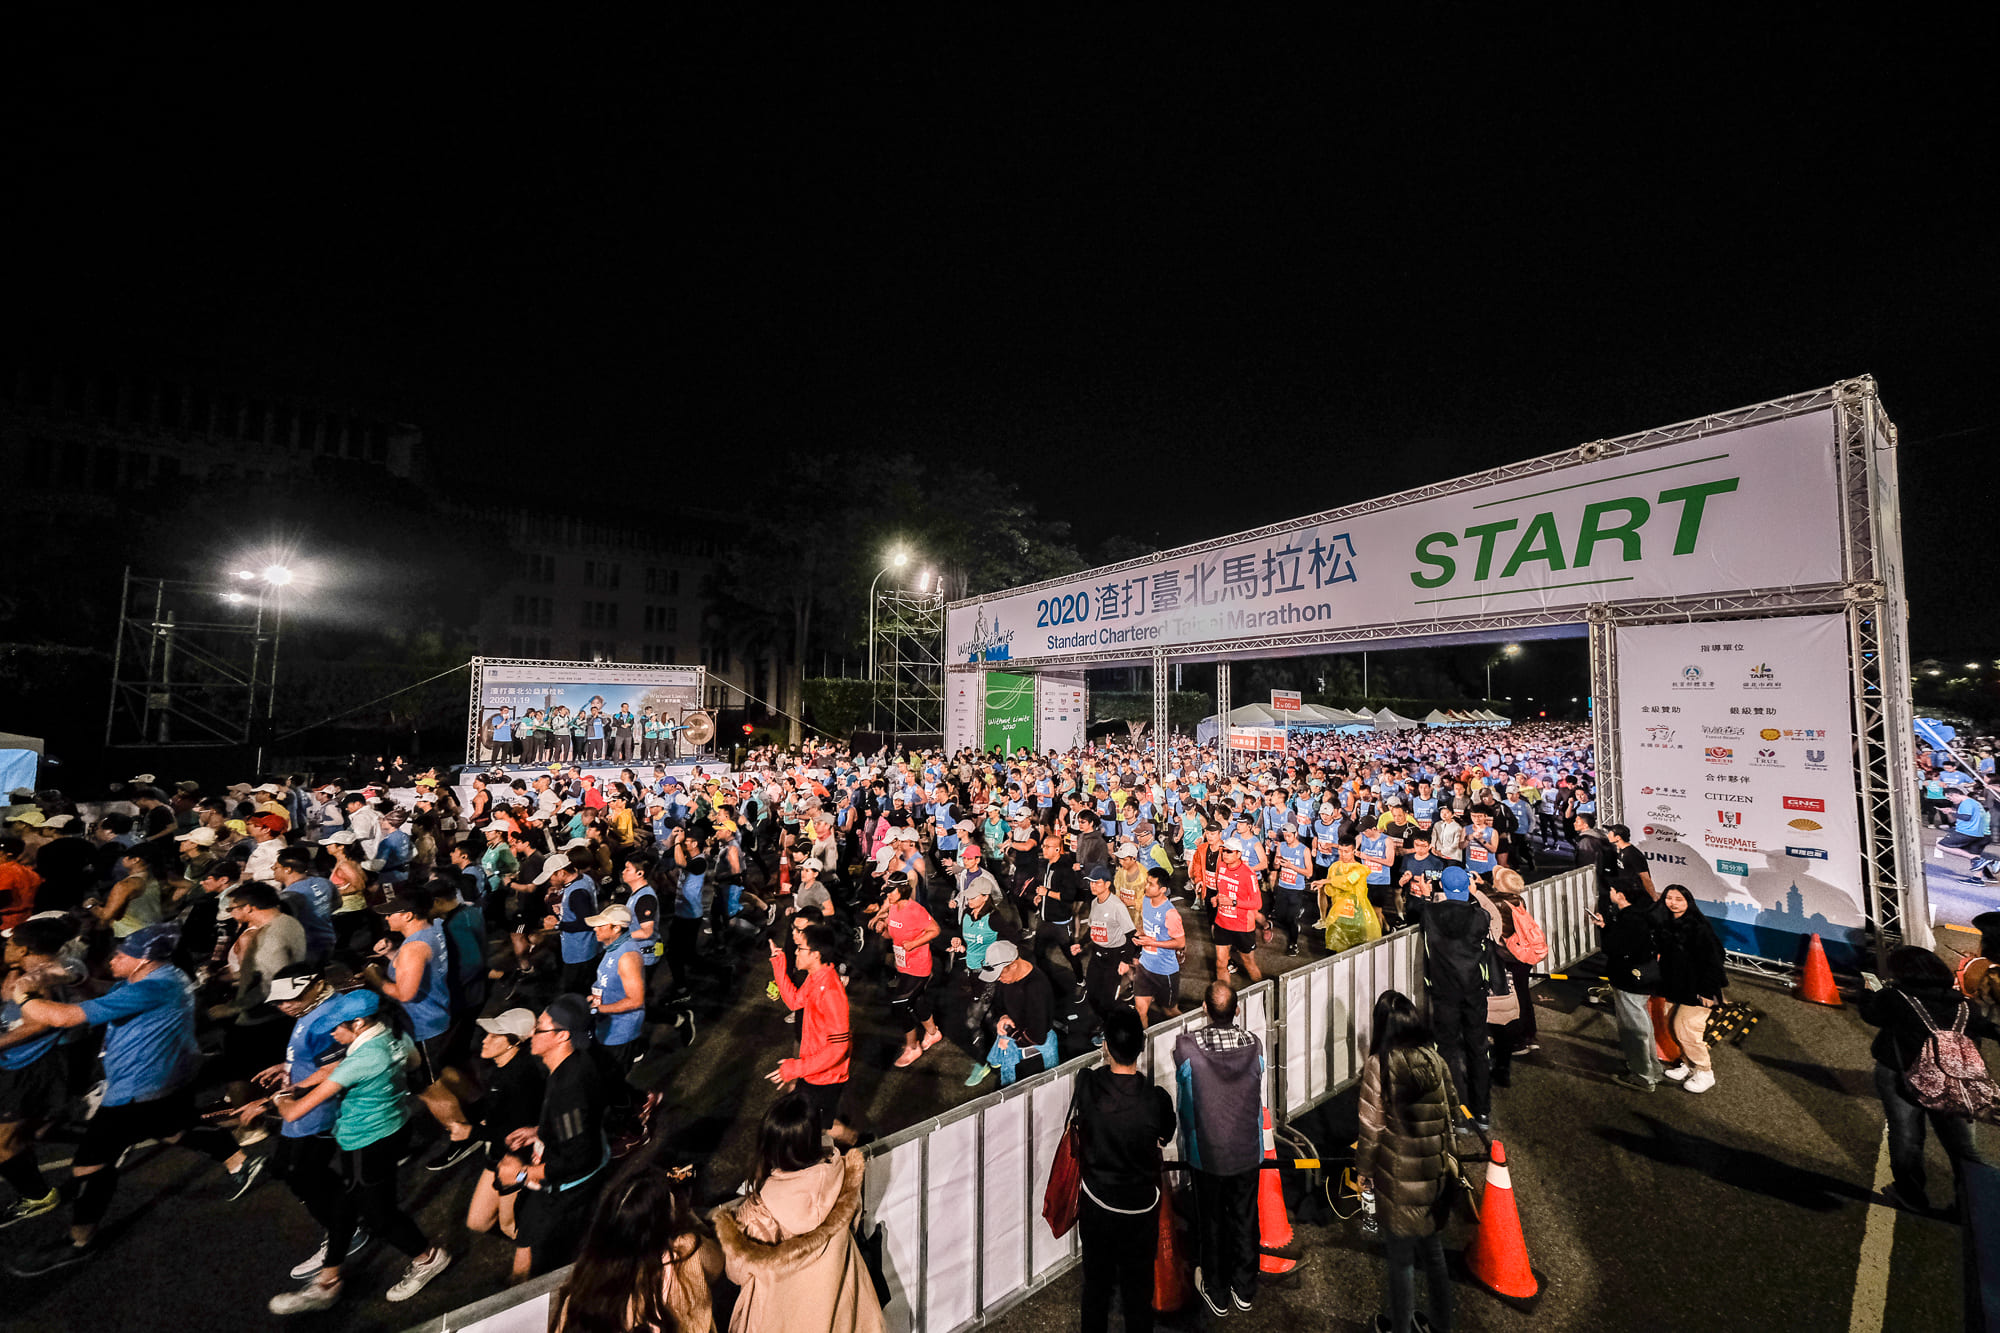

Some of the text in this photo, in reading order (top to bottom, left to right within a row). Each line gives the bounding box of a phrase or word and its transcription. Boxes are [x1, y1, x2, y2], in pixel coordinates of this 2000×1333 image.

[1410, 477, 1740, 589] START
[1037, 532, 1358, 628] 2020 渣打臺北馬拉松
[1047, 603, 1332, 650] Standard Chartered Taiei Marathon
[957, 629, 1015, 656] Without Limits
[1700, 644, 1745, 653] 指導單位
[1705, 773, 1751, 784] 合作夥伴
[1704, 792, 1753, 804] CITIZEN
[1787, 799, 1820, 807] GNC
[1646, 852, 1688, 866] UNIX
